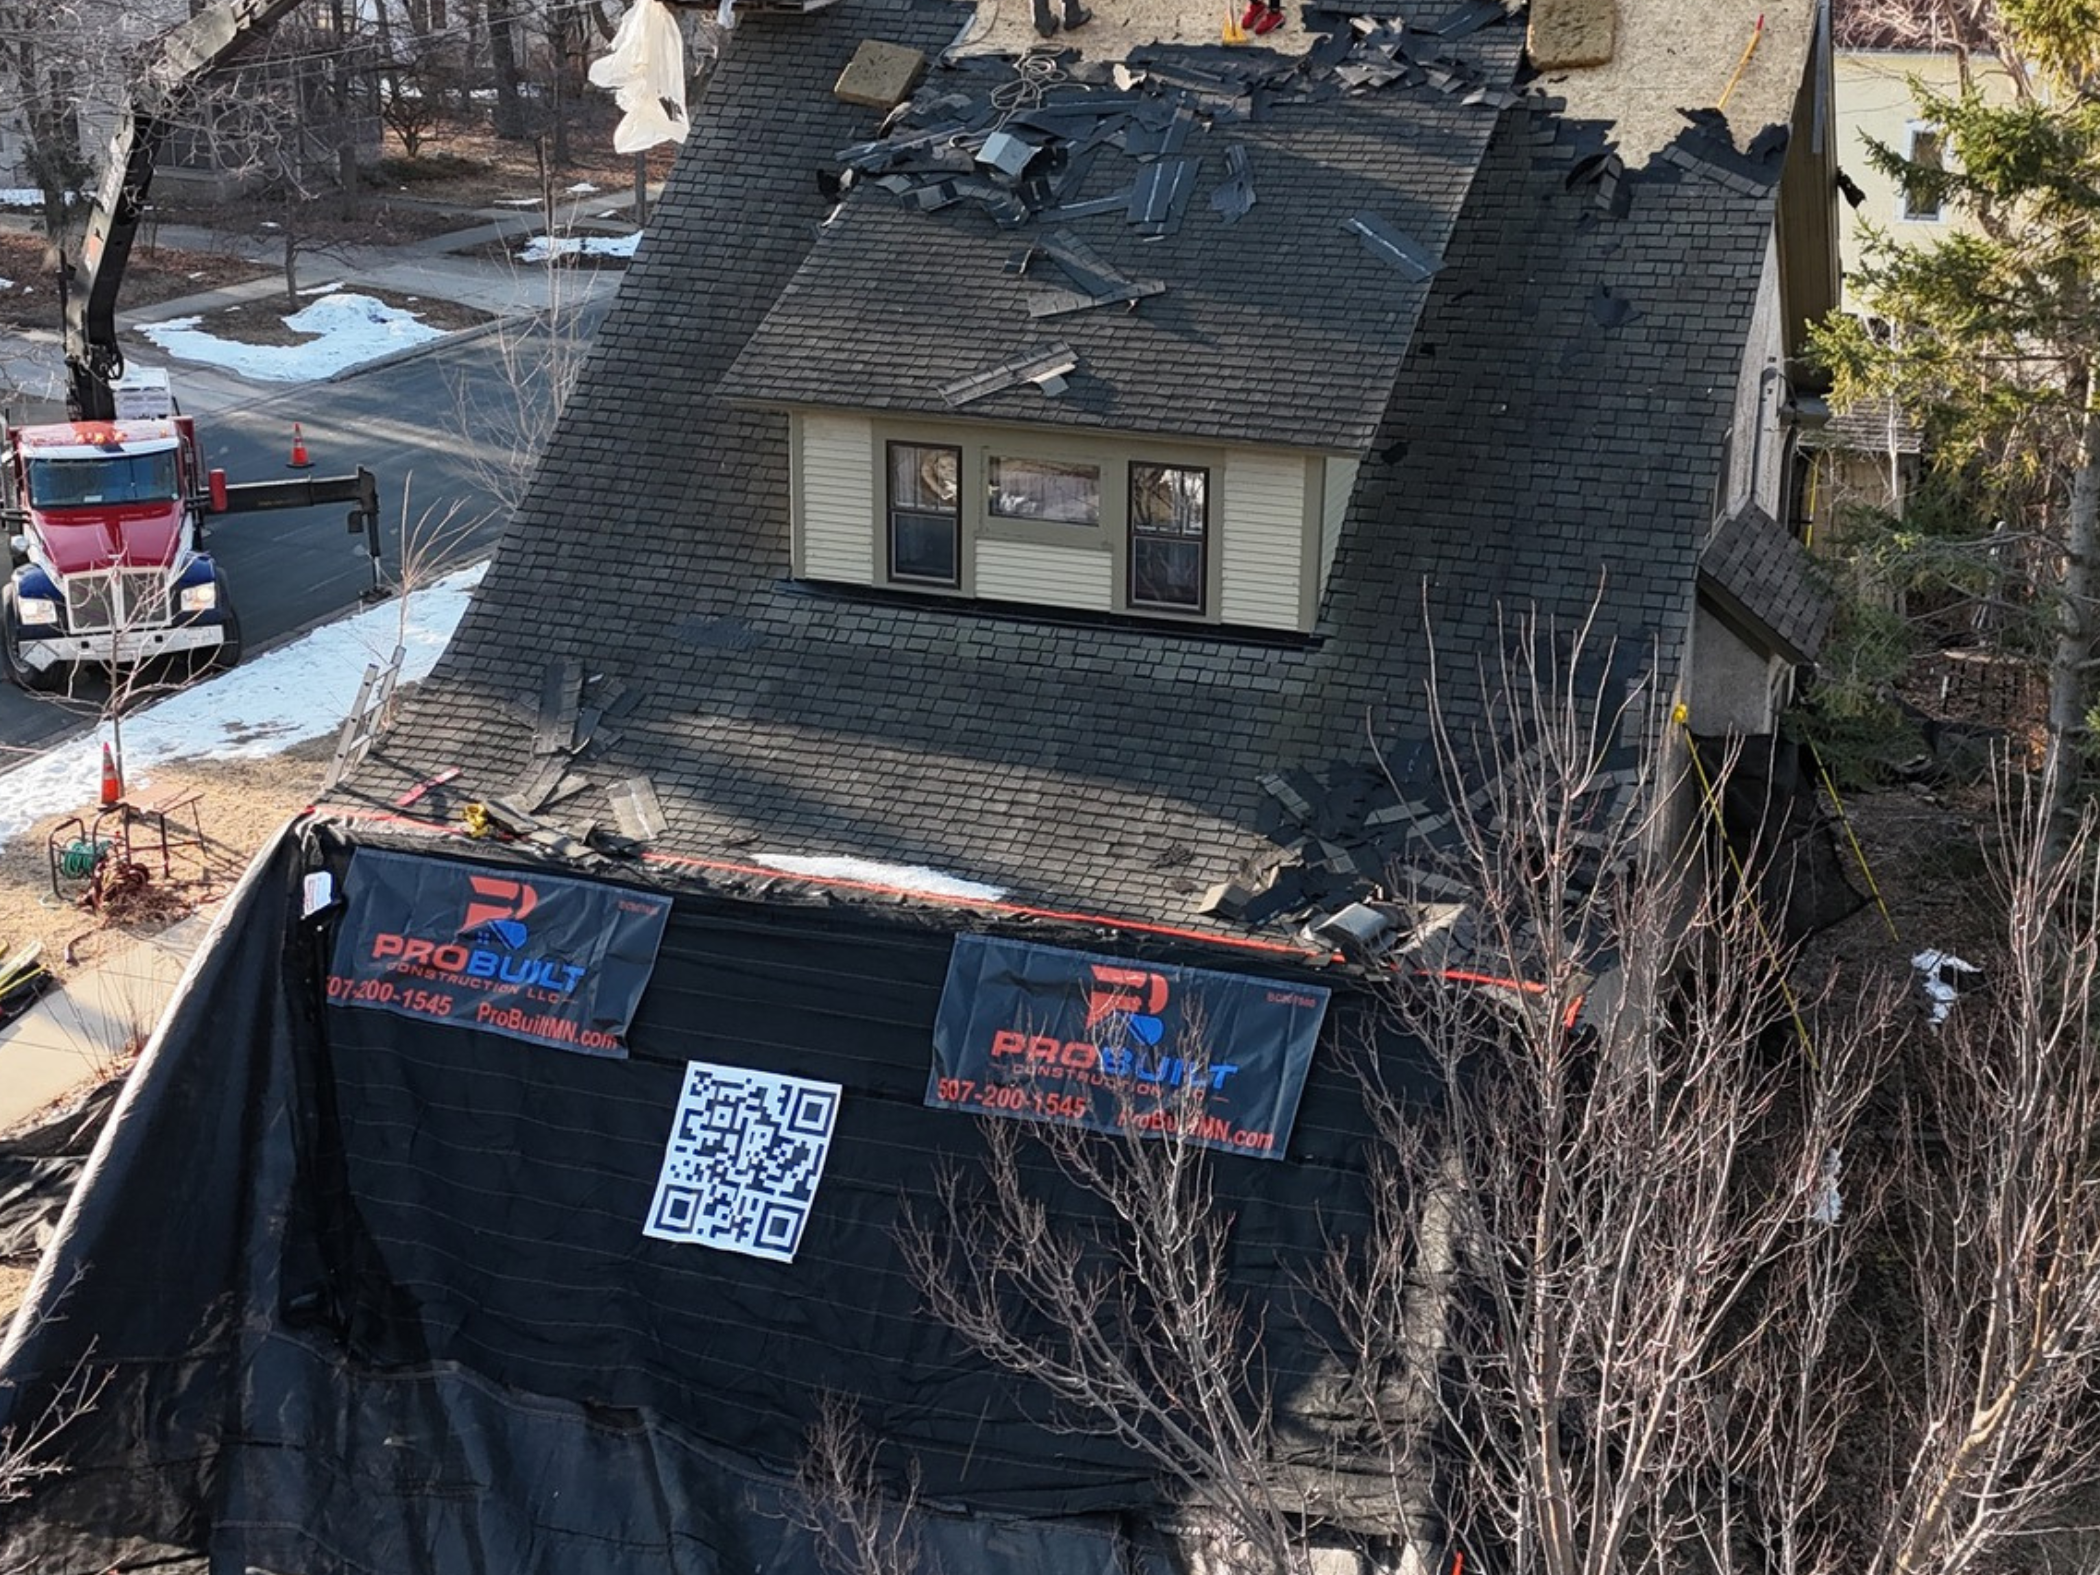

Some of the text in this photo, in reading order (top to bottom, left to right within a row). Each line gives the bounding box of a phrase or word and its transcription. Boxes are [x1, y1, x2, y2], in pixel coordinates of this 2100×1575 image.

[371, 933, 586, 993] PROBUILT
[386, 962, 562, 1004] CONSTRUCTION LLC
[327, 976, 453, 1016] 07-200-1545
[990, 1030, 1239, 1089] PROBUILT
[937, 1076, 1086, 1119] 507-200-1545
